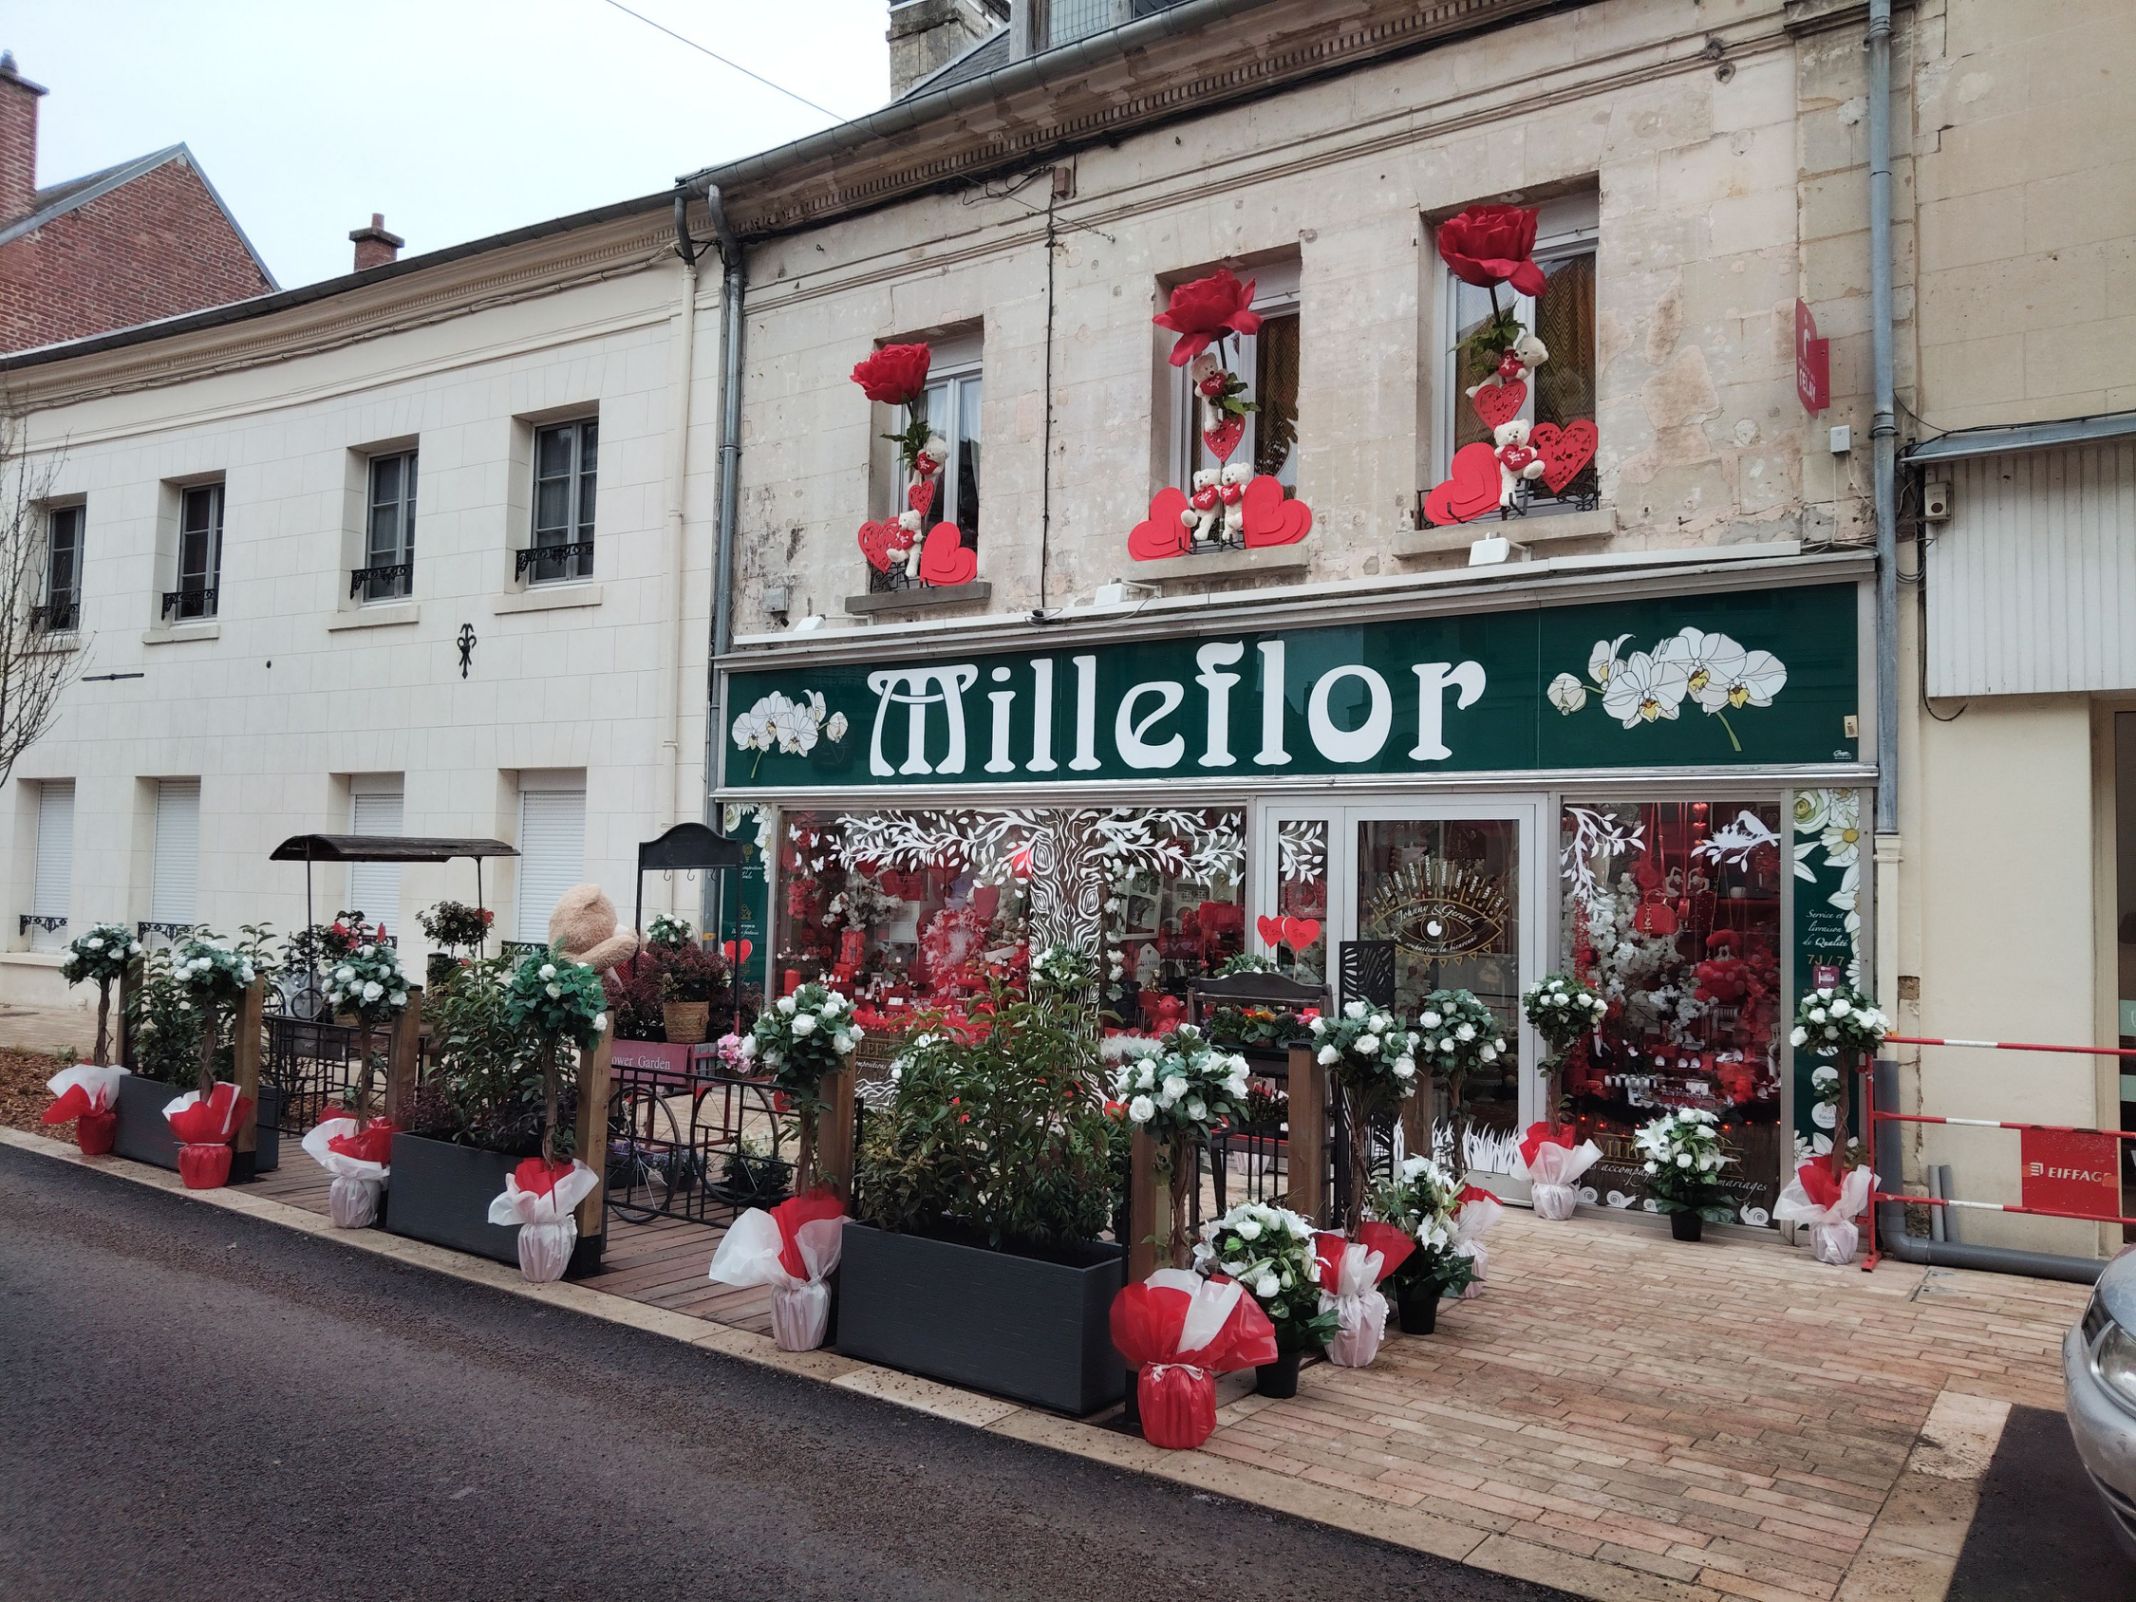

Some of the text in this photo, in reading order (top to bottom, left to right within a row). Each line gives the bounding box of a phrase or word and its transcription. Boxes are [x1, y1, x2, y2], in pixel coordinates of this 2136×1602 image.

[867, 640, 1486, 777] Milleflor
[1806, 909, 1845, 919] Service et
[1439, 942, 1447, 953] la
[611, 1055, 671, 1070] ower Garden
[2048, 1167, 2106, 1183] EIFFAG
